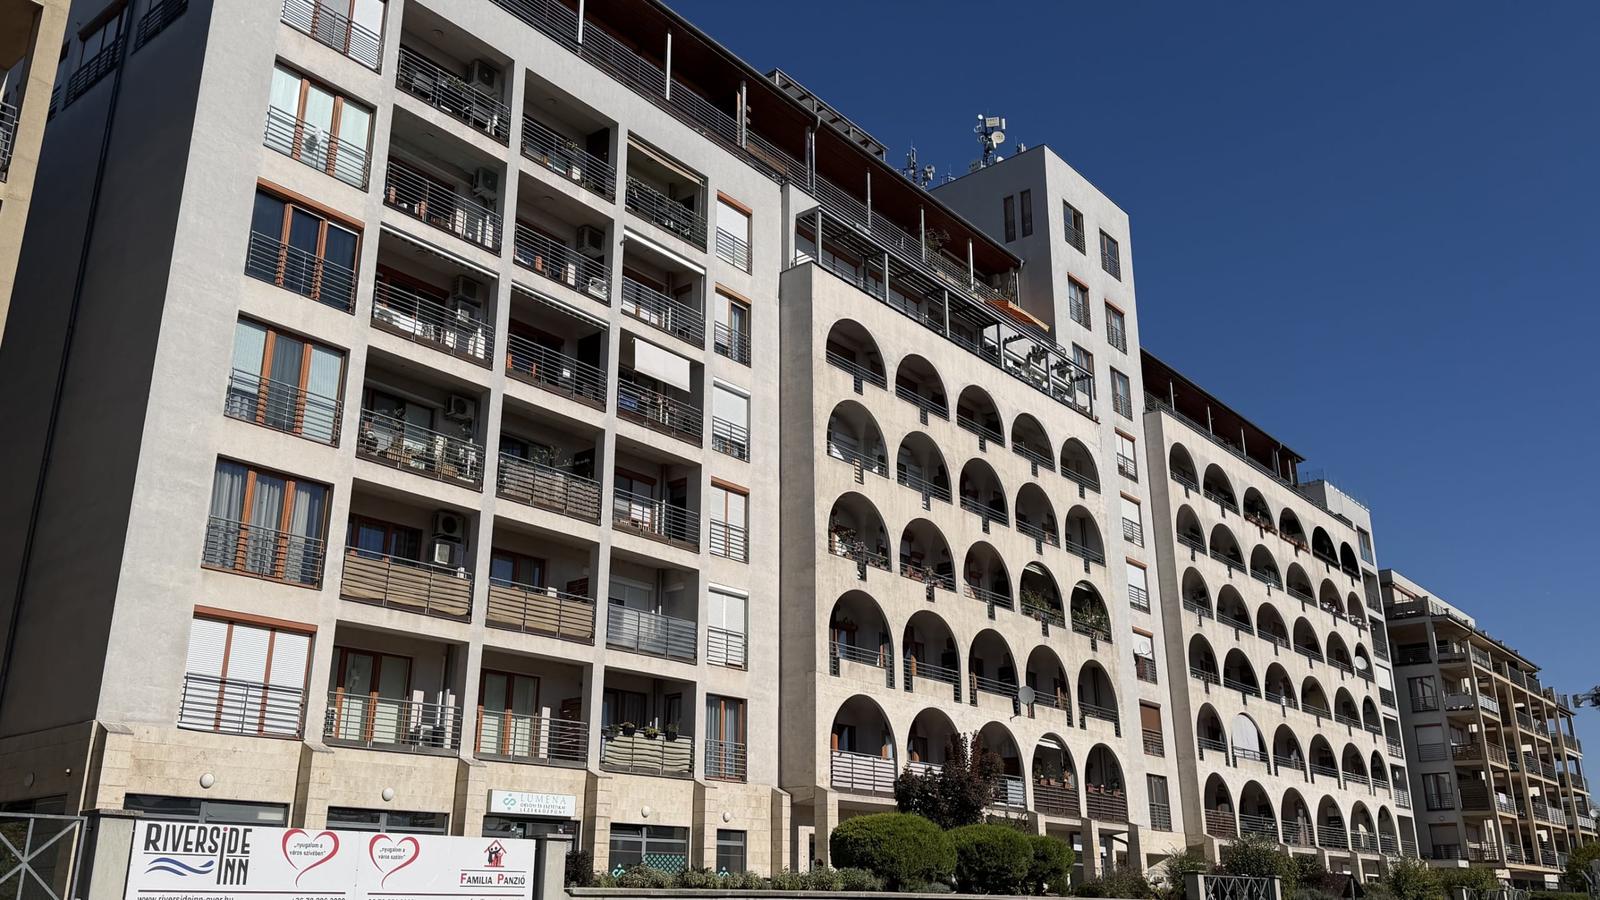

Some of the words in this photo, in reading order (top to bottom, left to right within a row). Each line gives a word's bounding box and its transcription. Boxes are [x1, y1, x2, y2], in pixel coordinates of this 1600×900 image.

[216, 857, 250, 885] INN
[460, 873, 492, 884] FAMILIA
[497, 874, 526, 884] PANZIÓ
